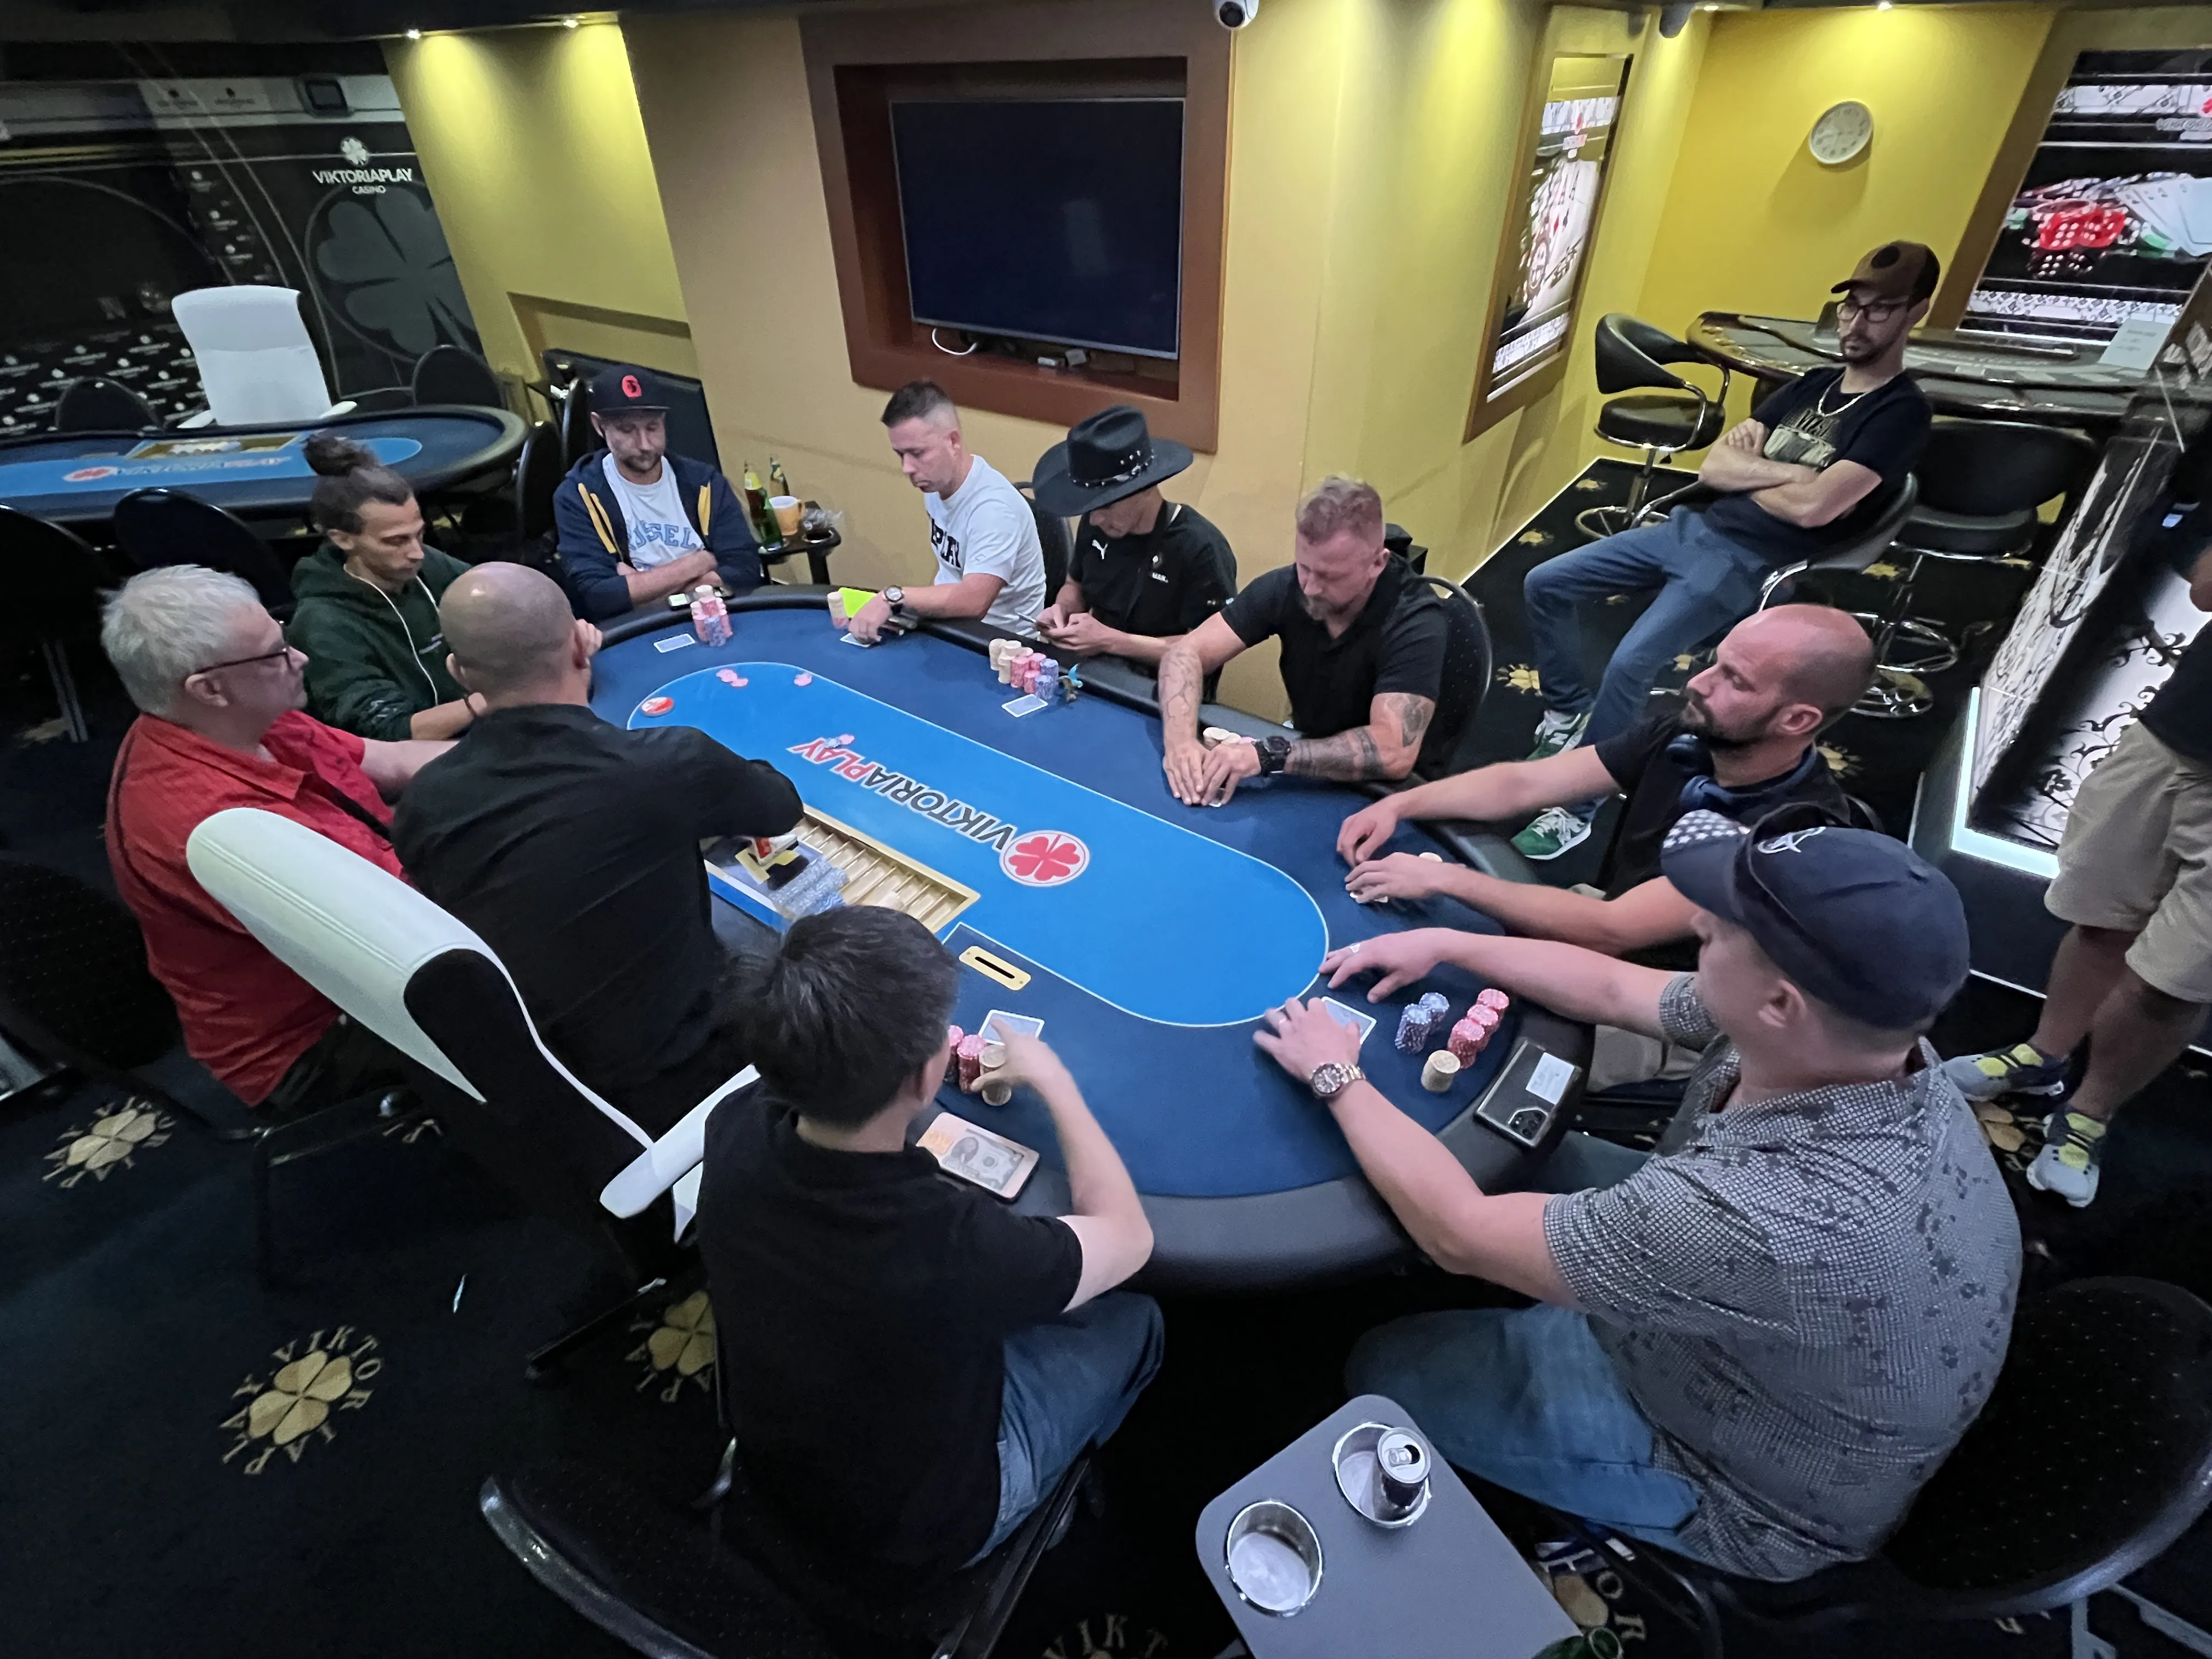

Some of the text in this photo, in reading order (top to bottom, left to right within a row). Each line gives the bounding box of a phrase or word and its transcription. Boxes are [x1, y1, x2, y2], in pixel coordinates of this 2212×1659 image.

[312, 168, 413, 184] VIKTORIAPLAY
[352, 185, 386, 195] CASINO
[788, 738, 1016, 851] VIKTORIAPLAY
